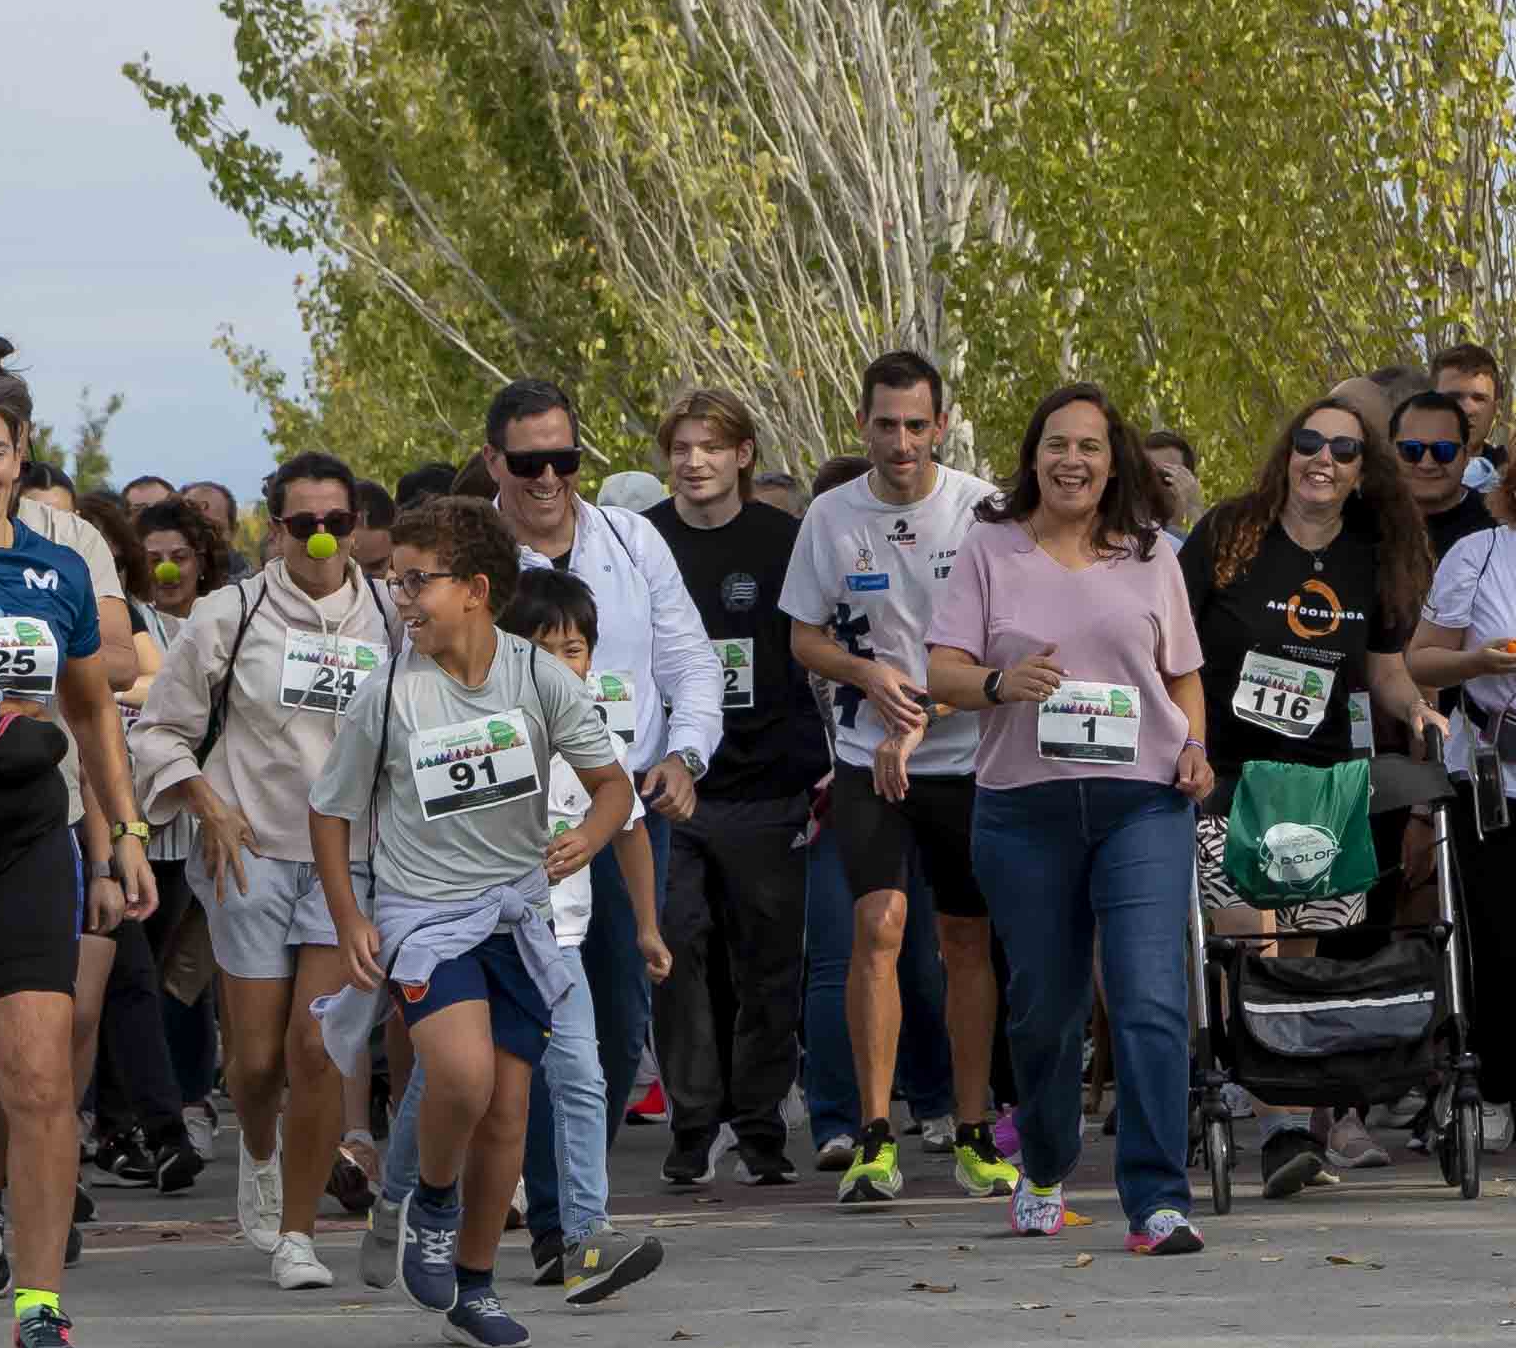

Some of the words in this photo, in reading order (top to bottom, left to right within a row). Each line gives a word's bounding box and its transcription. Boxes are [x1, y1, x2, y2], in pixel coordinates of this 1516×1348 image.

[312, 666, 357, 695] 24
[1252, 687, 1311, 722] 116
[1081, 716, 1096, 743] 1
[448, 755, 498, 791] 91
